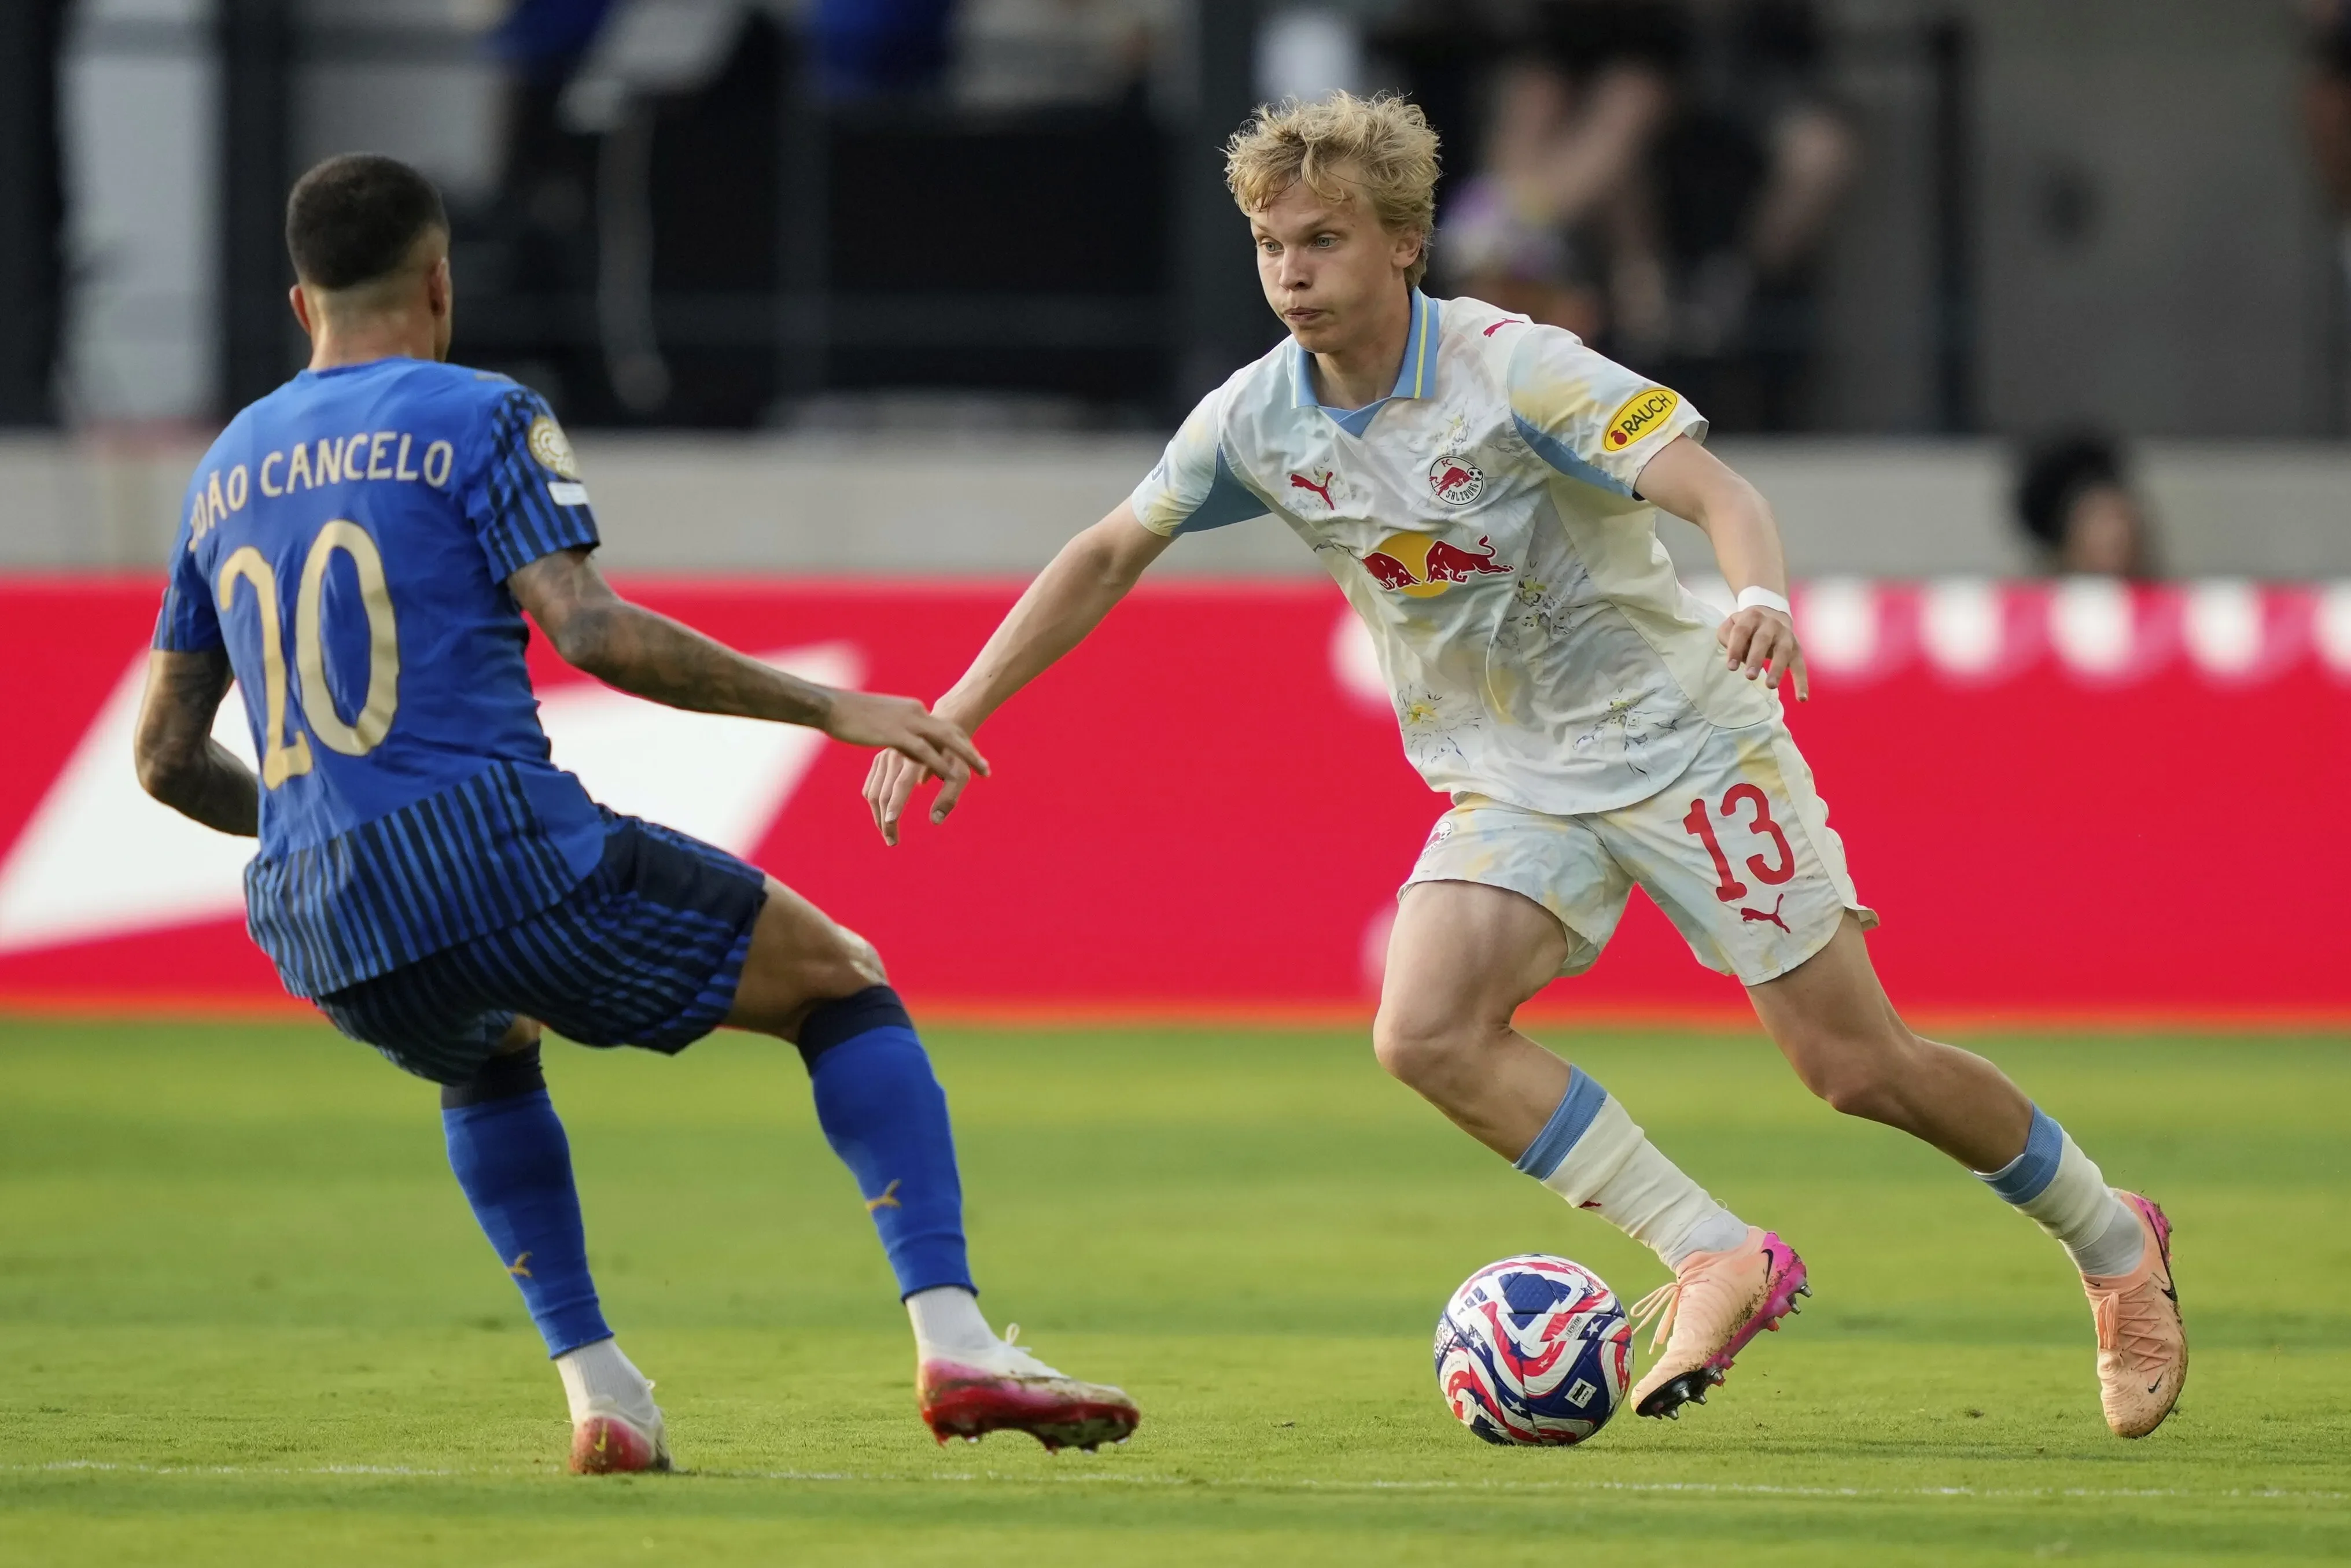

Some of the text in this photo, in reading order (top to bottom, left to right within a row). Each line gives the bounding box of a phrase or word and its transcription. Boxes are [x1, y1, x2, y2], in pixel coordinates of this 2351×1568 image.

[1620, 393, 1672, 436] RAUCH
[260, 432, 453, 497] CANCELO
[1441, 459, 1453, 467] FC
[1446, 482, 1479, 501] SALZBURG
[220, 519, 399, 790] 20
[1683, 784, 1794, 902] 13
